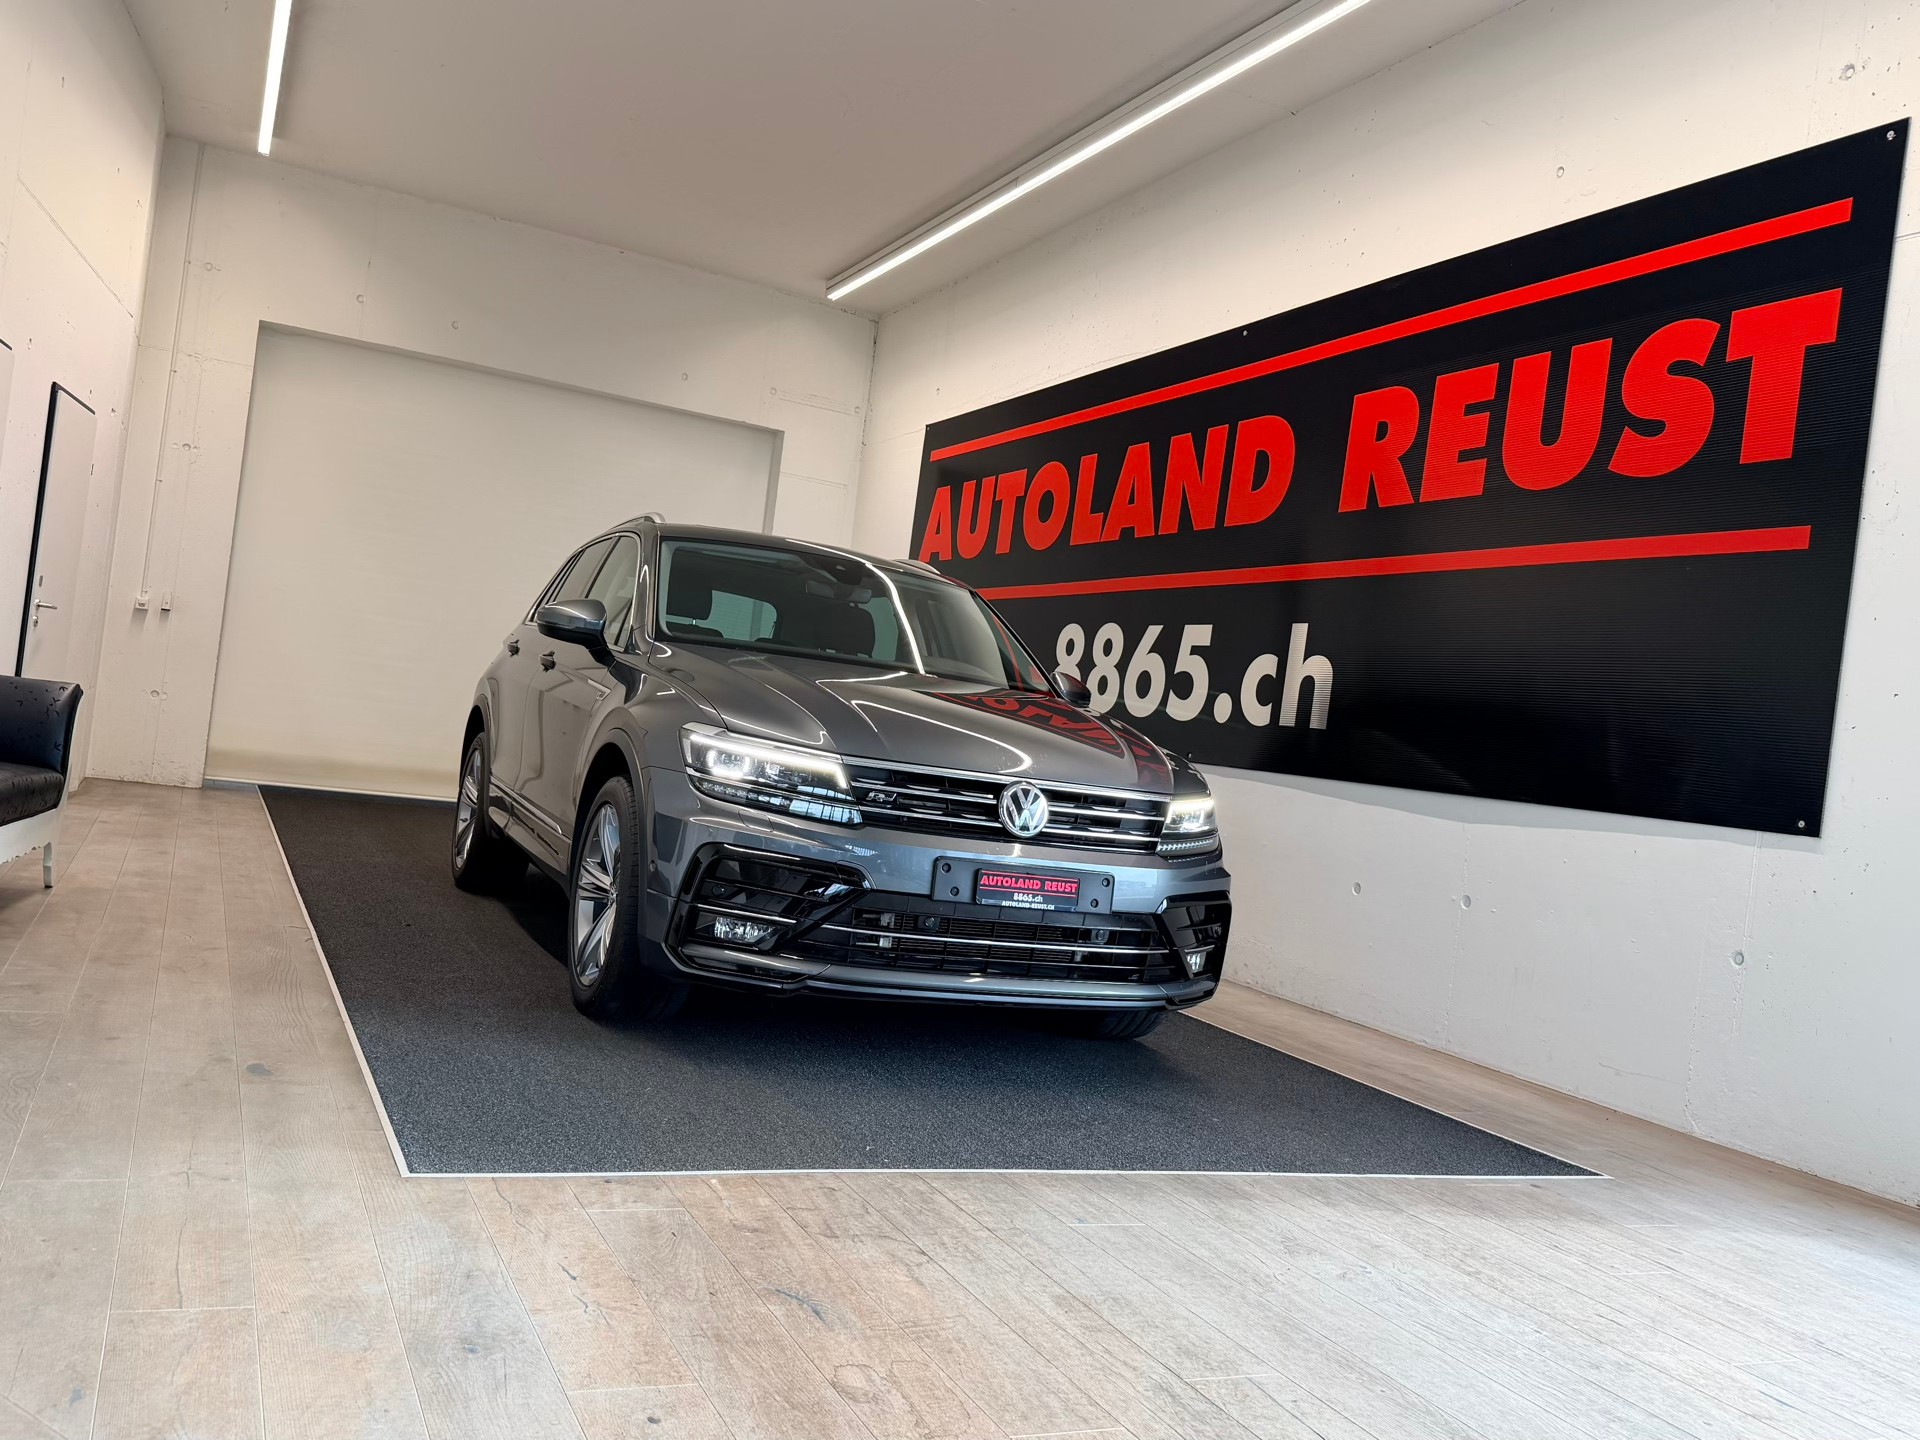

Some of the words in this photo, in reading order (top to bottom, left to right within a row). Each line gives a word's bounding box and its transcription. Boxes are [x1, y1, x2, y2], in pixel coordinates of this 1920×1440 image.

[919, 415, 1296, 564] AUTOLAND
[1338, 287, 1843, 513] REUST
[1052, 622, 1334, 730] 8865.ch
[980, 875, 1042, 890] AUTOLAND
[1044, 880, 1078, 893] REUST
[1001, 900, 1055, 910] AUTOLAND-REUST.CH
[1013, 892, 1043, 903] 8865.ch
